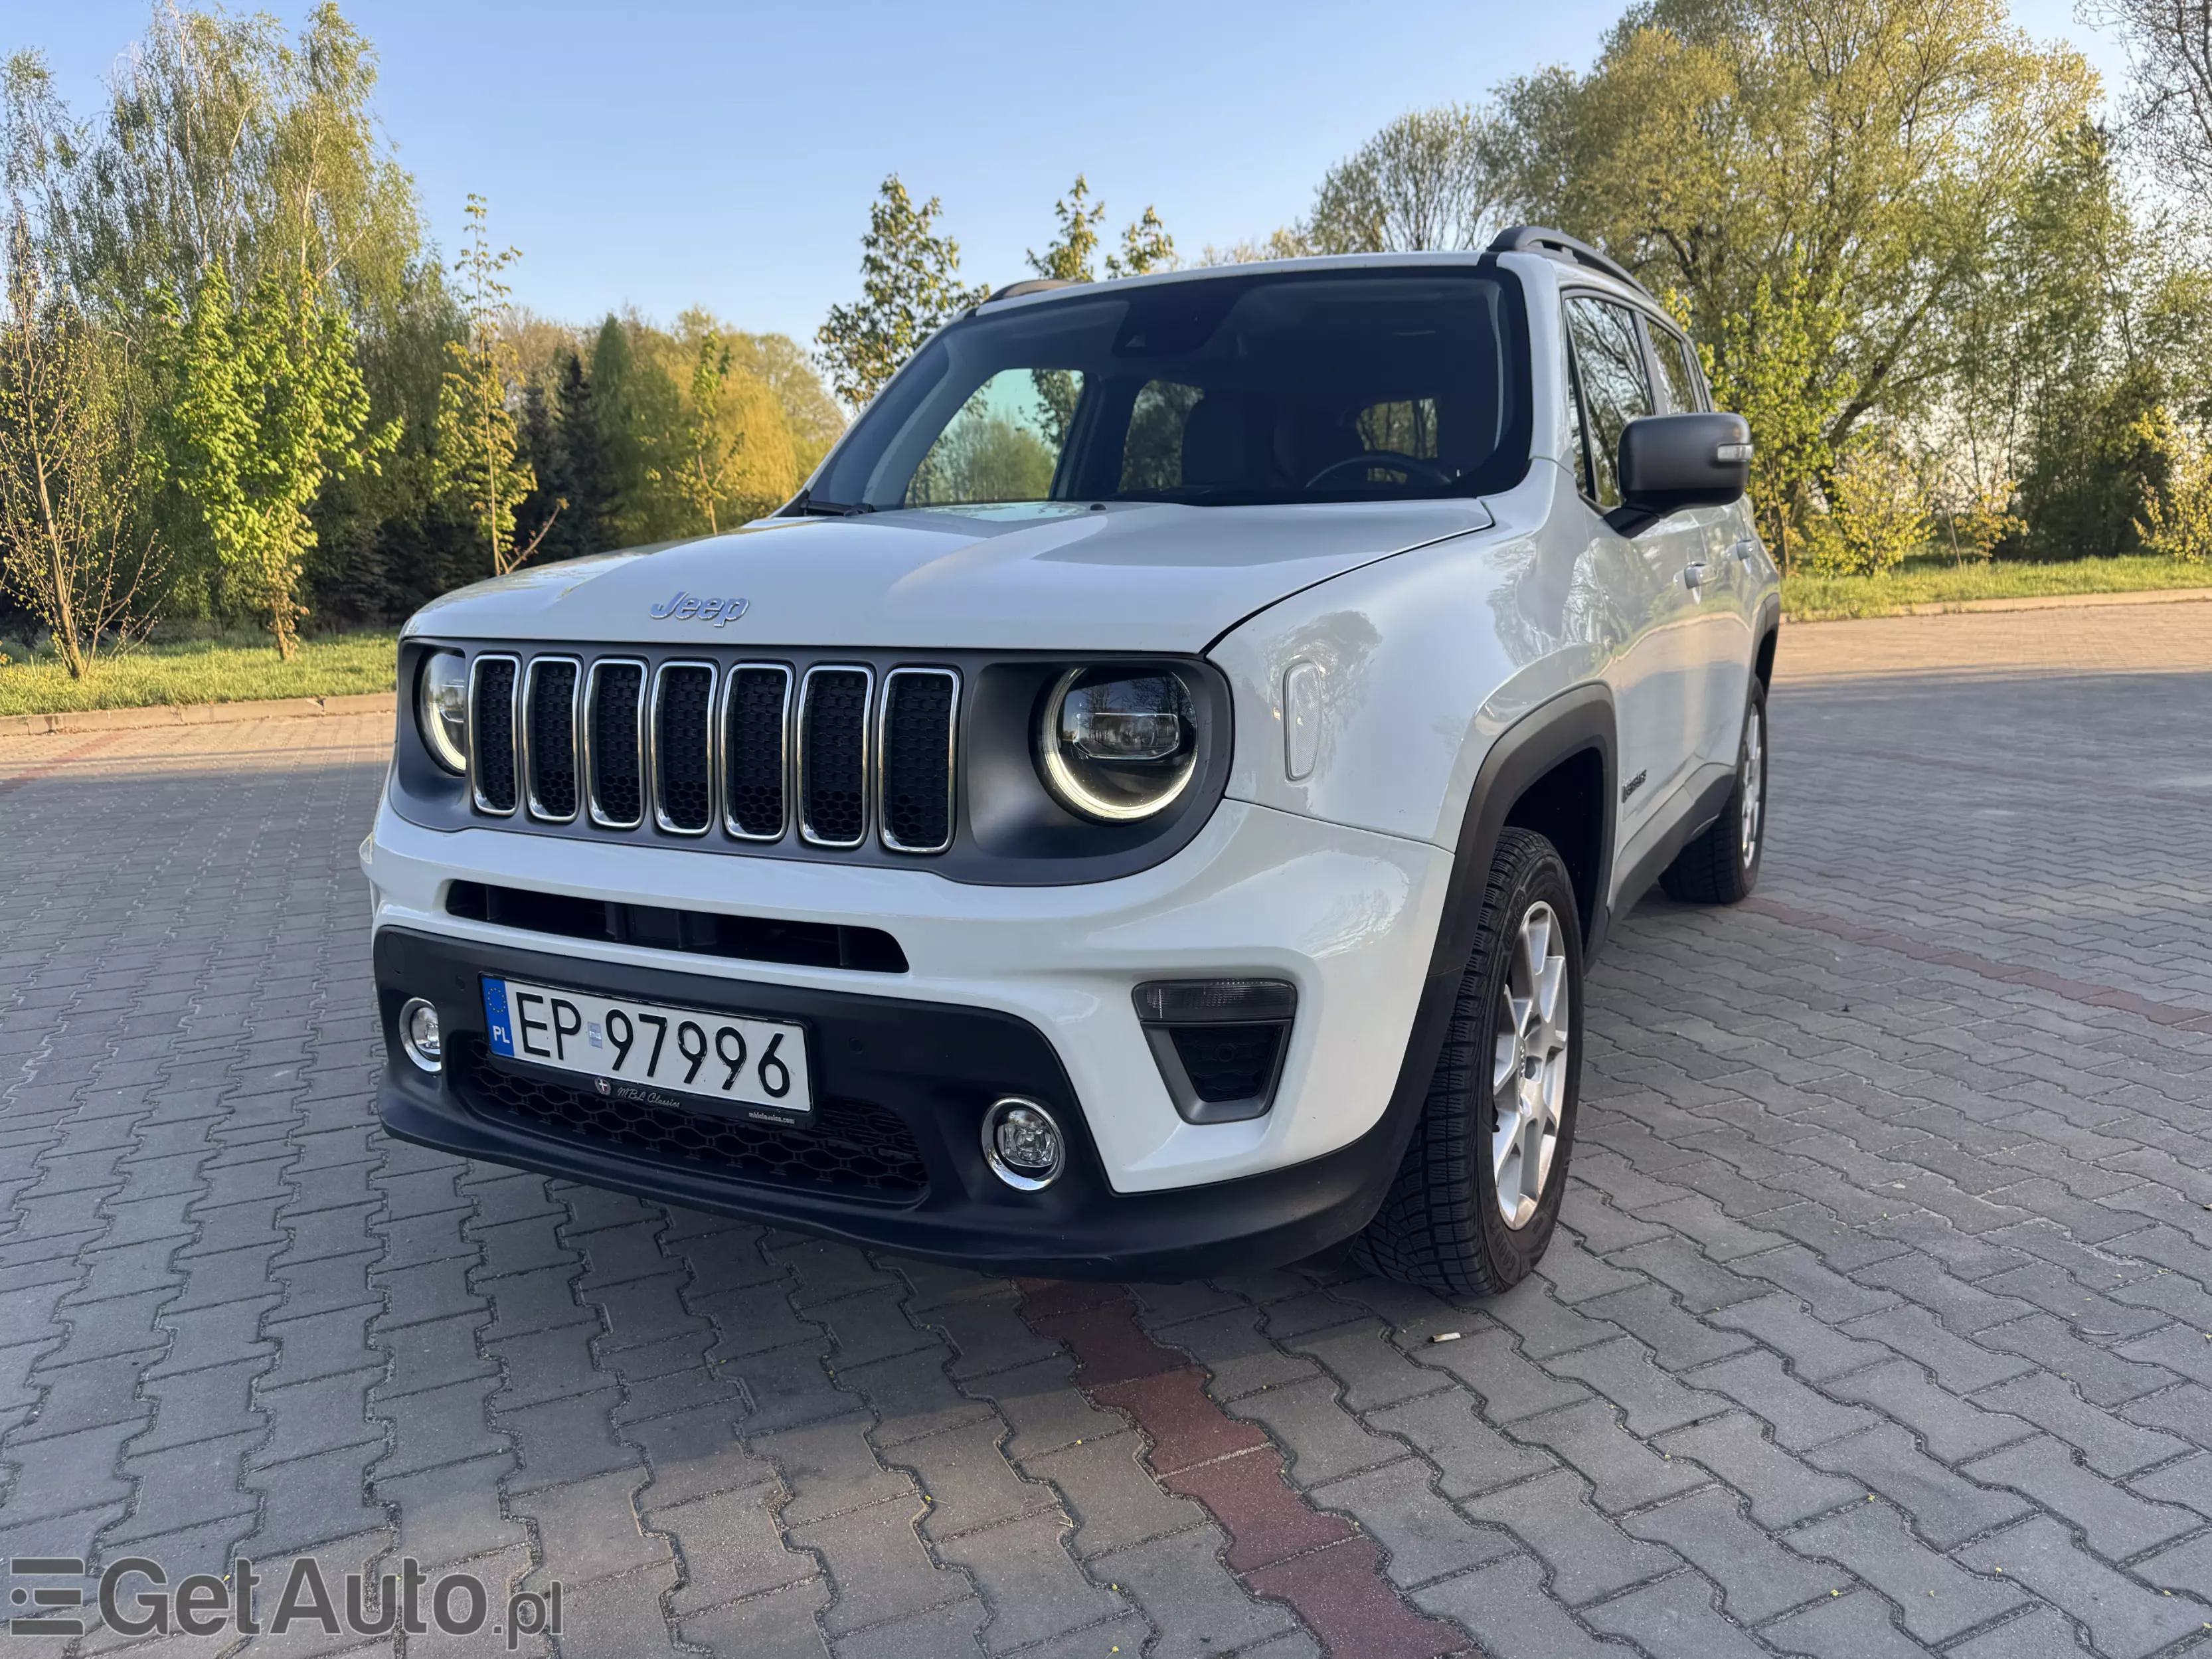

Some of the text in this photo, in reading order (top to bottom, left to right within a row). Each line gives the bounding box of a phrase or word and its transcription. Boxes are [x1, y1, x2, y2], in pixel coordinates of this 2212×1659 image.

[649, 591, 750, 628] Jeep
[492, 1025, 511, 1044] PL
[515, 992, 791, 1098] EP 97996
[617, 1087, 681, 1108] MBL Classics
